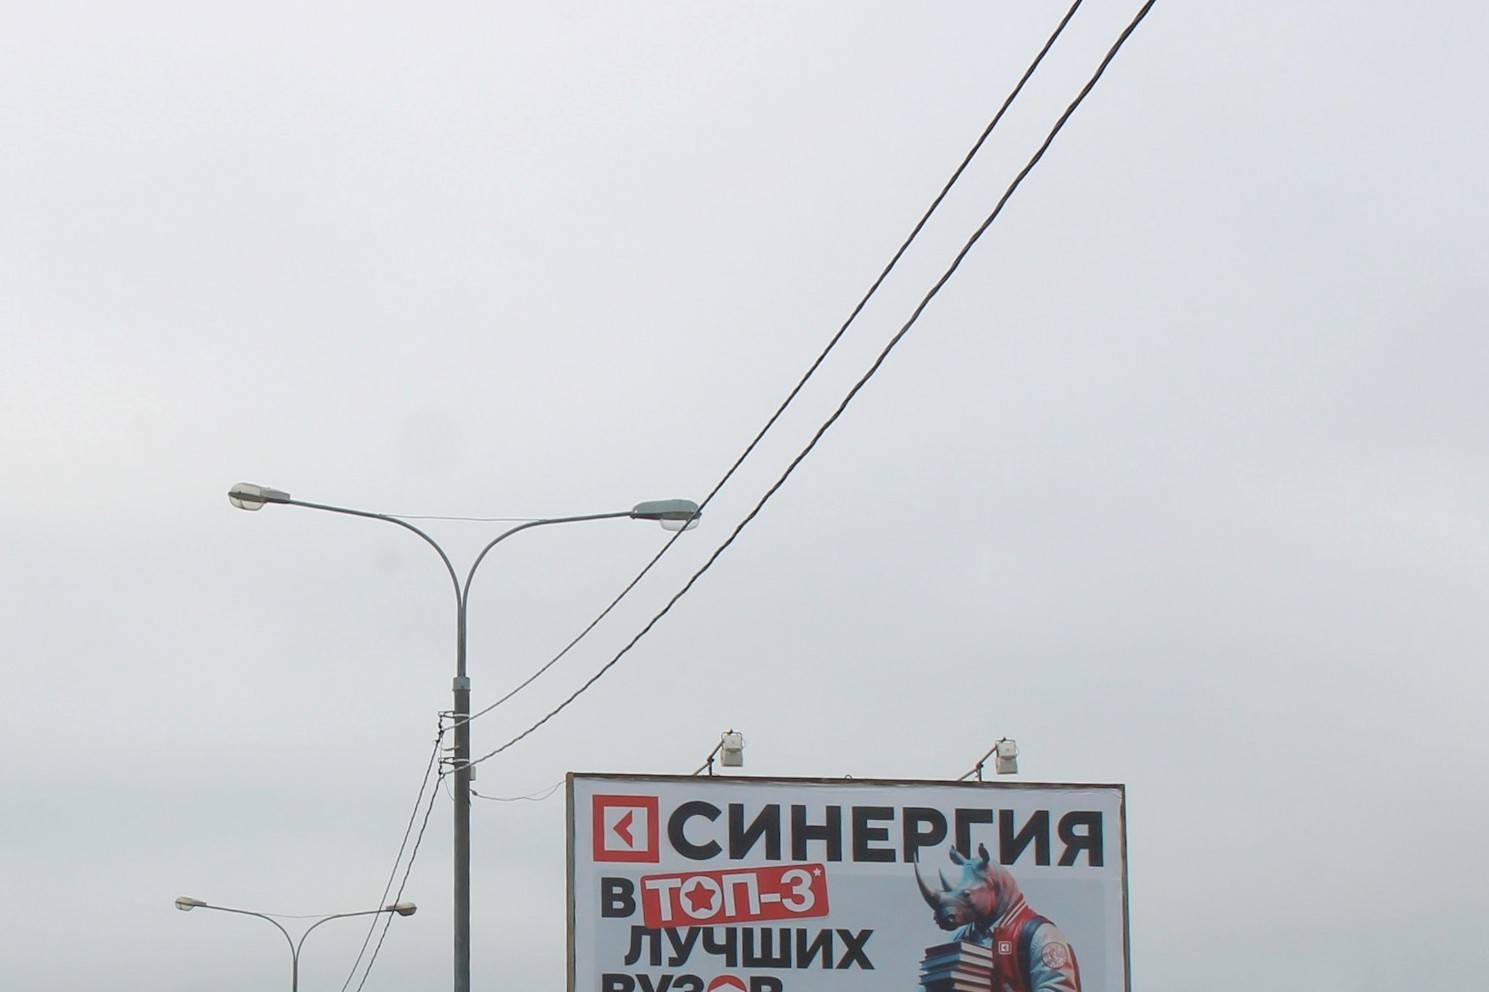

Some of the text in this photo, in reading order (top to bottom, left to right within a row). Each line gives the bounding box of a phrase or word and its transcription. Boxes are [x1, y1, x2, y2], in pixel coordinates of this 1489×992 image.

[666, 799, 1105, 868] СИНЕРГИЯ
[600, 876, 637, 919] В
[623, 927, 876, 970] ЛУЧШИХ
